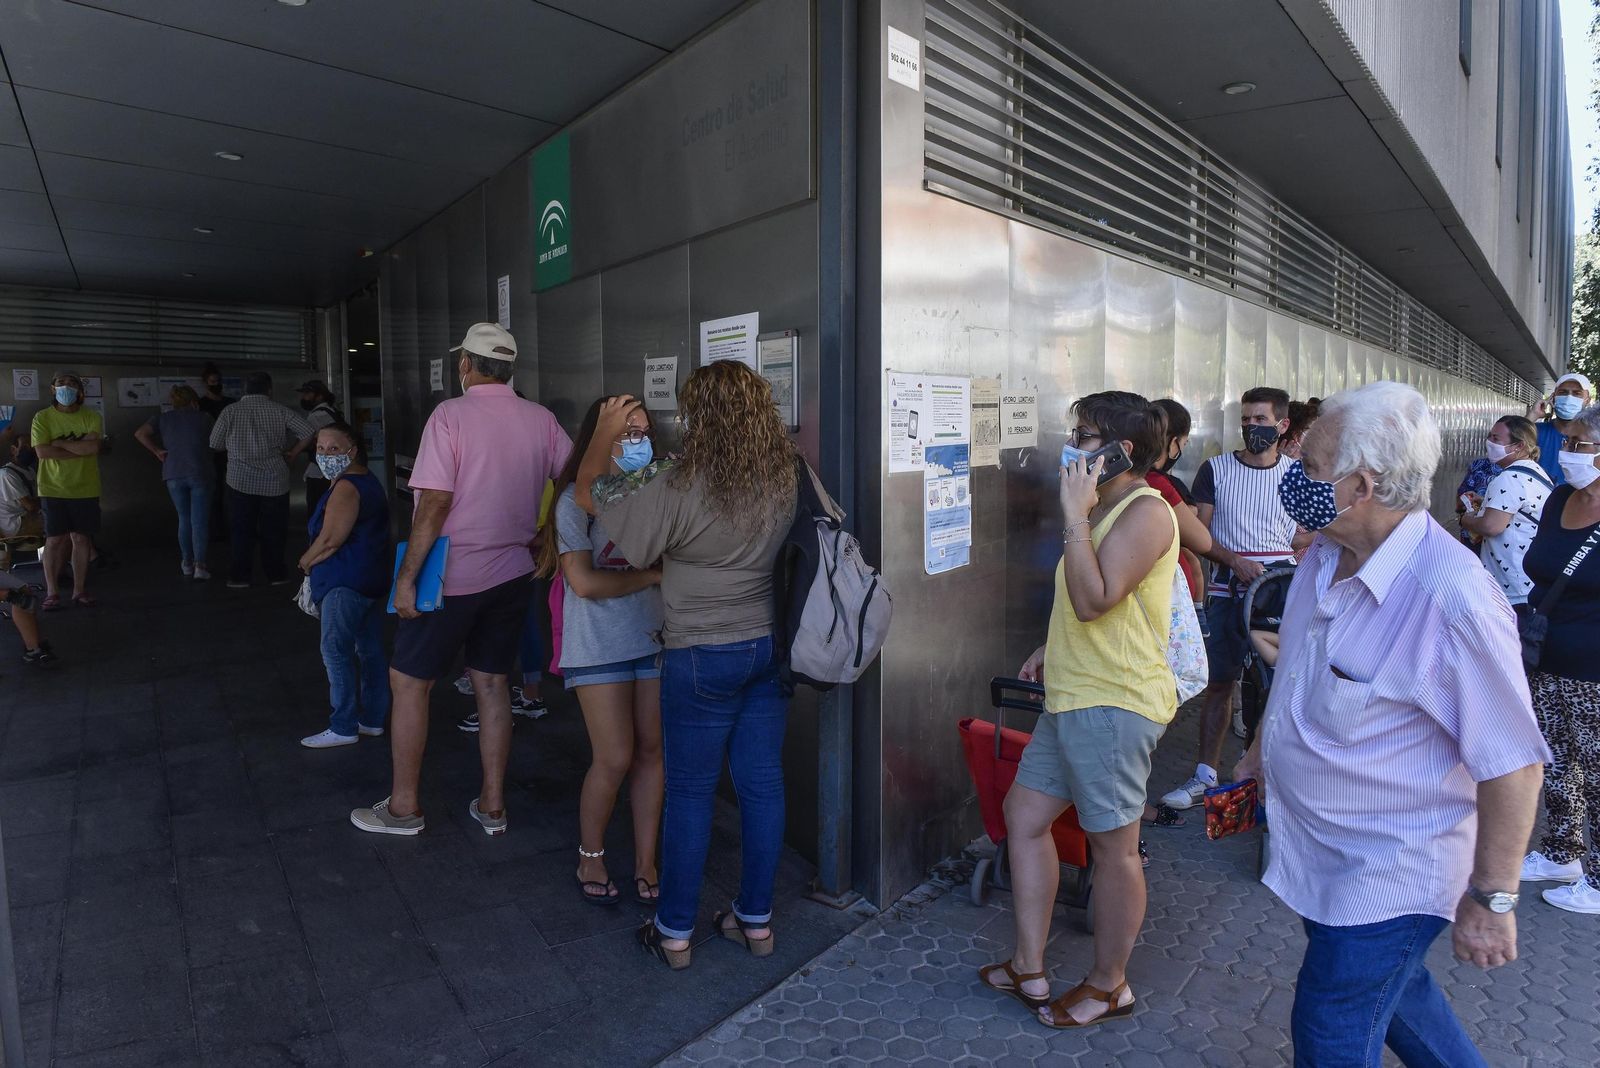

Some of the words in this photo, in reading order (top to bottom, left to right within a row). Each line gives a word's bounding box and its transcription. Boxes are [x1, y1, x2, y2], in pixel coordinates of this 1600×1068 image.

[891, 52, 899, 63] 902
[900, 57, 905, 65] 44
[906, 60, 911, 68] 11
[682, 107, 722, 147] Centro
[726, 92, 743, 125] de
[747, 63, 788, 115] Salud
[724, 136, 736, 172] El
[1014, 425, 1033, 433] PERSONAS
[1563, 545, 1592, 576] BIMBA
[1586, 535, 1598, 544] Y
